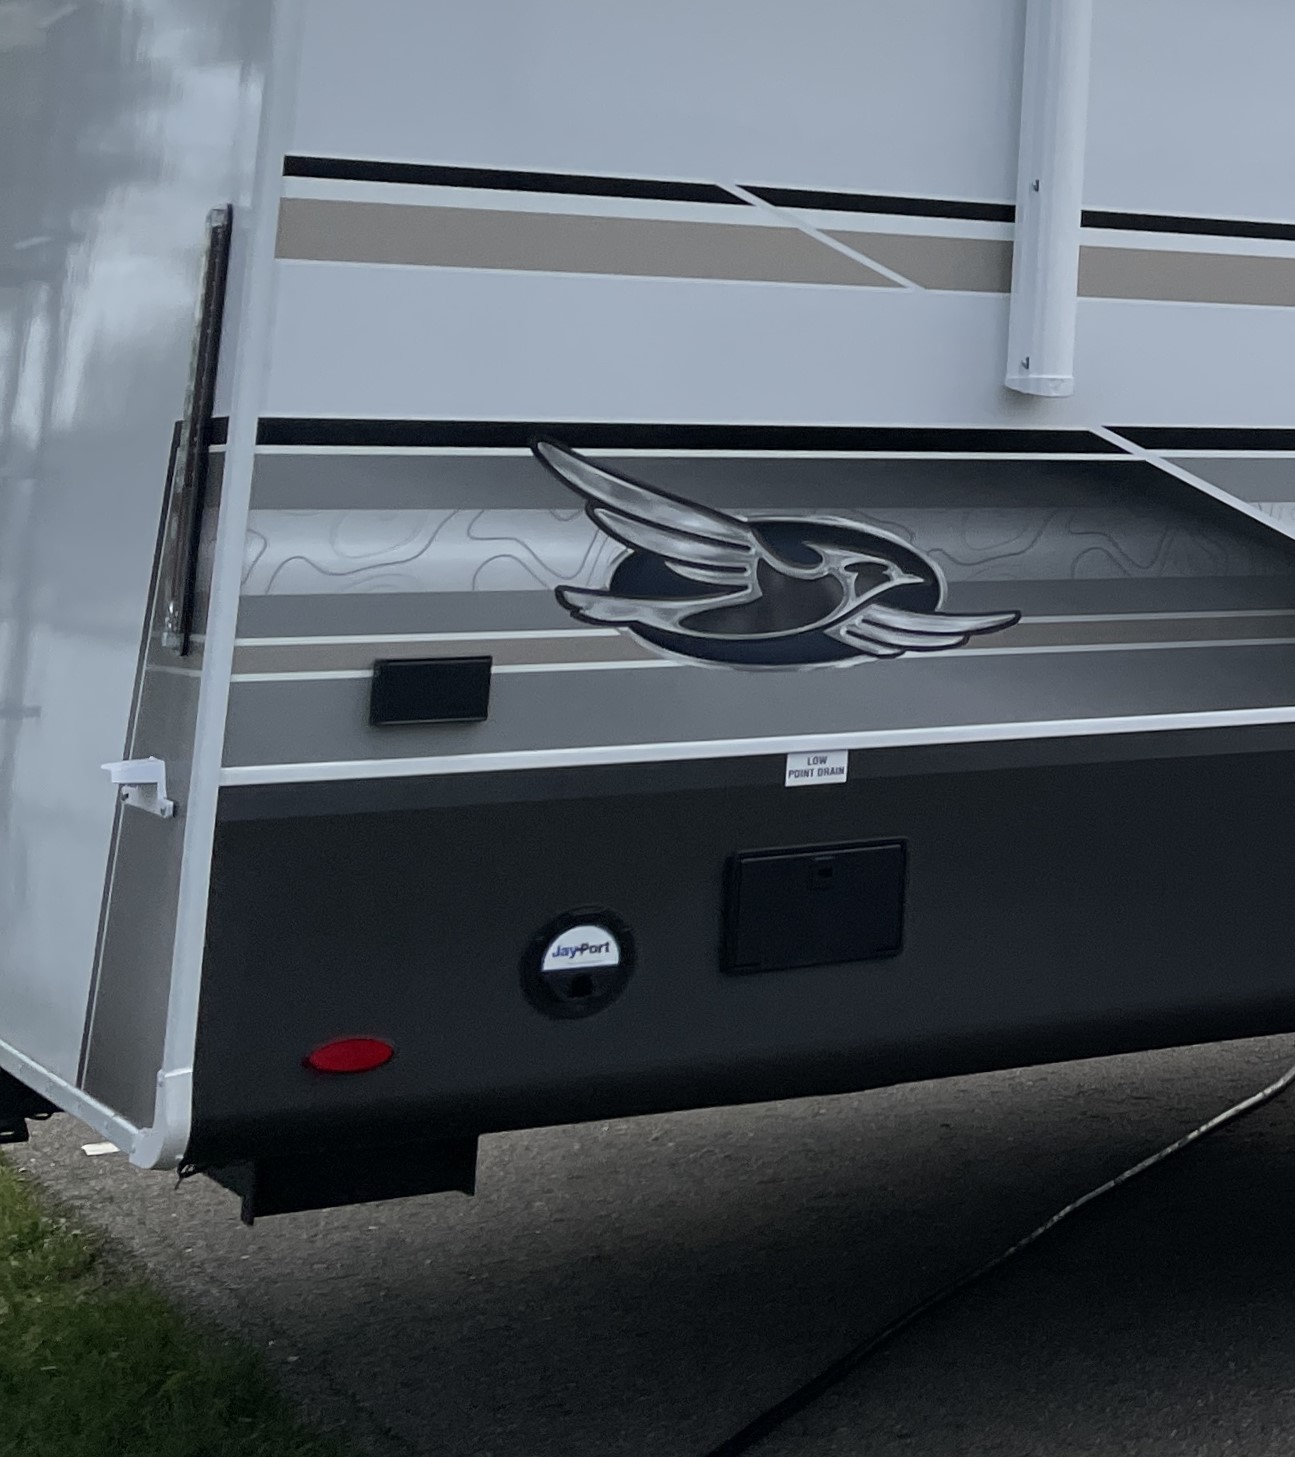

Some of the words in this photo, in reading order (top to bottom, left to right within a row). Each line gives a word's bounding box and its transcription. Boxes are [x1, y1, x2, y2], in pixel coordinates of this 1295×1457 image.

[807, 756, 828, 766] LOW
[788, 768, 815, 778] POINT
[817, 766, 845, 777] DRAIN
